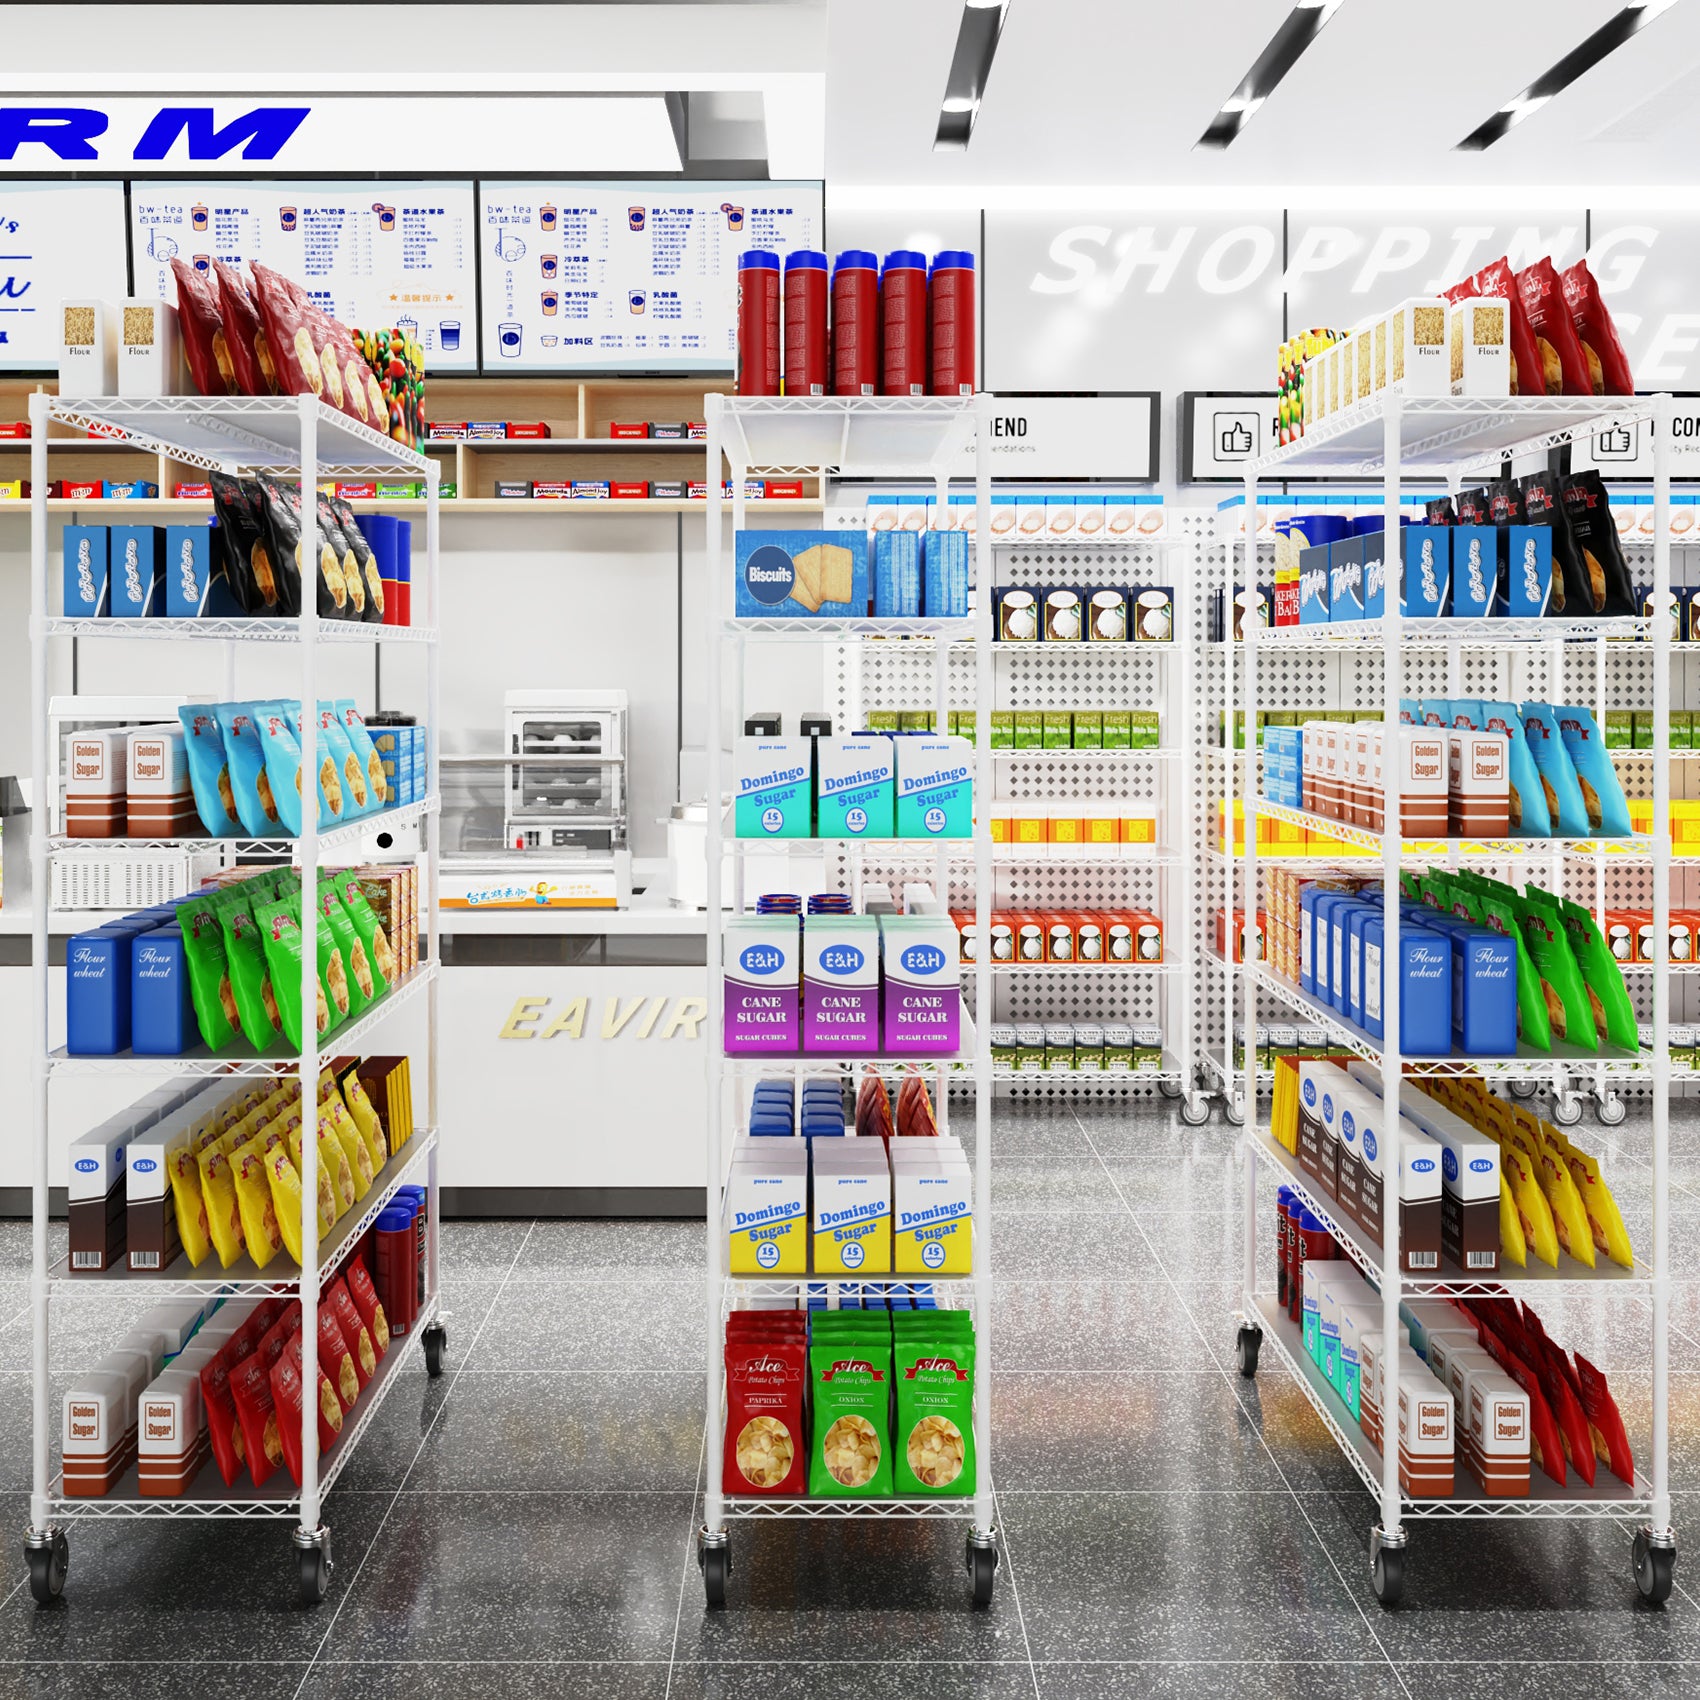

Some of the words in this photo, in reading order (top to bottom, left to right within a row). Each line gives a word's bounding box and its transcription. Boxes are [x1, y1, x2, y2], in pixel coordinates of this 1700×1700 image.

[750, 567, 792, 582] Biscuits
[871, 715, 896, 724] Fresh
[1015, 715, 1041, 724] Fresh
[1044, 715, 1071, 724] Fresh
[1075, 715, 1101, 724] Fresh
[1104, 715, 1130, 724] Fresh
[1132, 715, 1158, 724] Fresh
[77, 746, 99, 756] Golden
[137, 746, 160, 756] Golden
[1415, 745, 1438, 756] Golden
[1476, 746, 1499, 756] Golden
[77, 763, 99, 776] Sugar
[137, 763, 160, 776] Sugar
[1415, 763, 1438, 776] Sugar
[1476, 763, 1499, 776] Sugar
[740, 766, 805, 791] Domingo
[824, 766, 889, 791] Domingo
[903, 766, 968, 791] Domingo
[754, 787, 796, 807] Sugar
[838, 787, 880, 807] Sugar
[917, 787, 959, 807] Sugar
[767, 812, 778, 822] 15
[850, 812, 862, 822] 15
[930, 812, 941, 822] 15
[74, 948, 105, 966] Flour
[139, 948, 171, 966] Flour
[746, 952, 779, 968] E&H
[826, 952, 859, 968] E&H
[907, 952, 940, 968] E&H
[1410, 948, 1443, 962] Flour
[1475, 948, 1508, 963] Flour
[74, 965, 105, 977] wheat
[139, 965, 170, 977] wheat
[1410, 965, 1442, 977] wheat
[1476, 965, 1508, 977] wheat
[742, 997, 781, 1007] CANE
[822, 997, 860, 1007] CANE
[903, 997, 942, 1007] CANE
[737, 1012, 786, 1022] SUGAR
[817, 1012, 866, 1022] SUGAR
[898, 1013, 947, 1022] SUGAR
[735, 1201, 800, 1226] Domingo
[820, 1201, 885, 1226] Domingo
[900, 1201, 966, 1226] Domingo
[749, 1221, 792, 1242] Sugar
[833, 1221, 876, 1242] Sugar
[914, 1221, 958, 1242] Sugar
[762, 1246, 774, 1256] 15
[847, 1246, 859, 1256] 15
[928, 1246, 940, 1256] 15
[749, 1354, 783, 1373] Ace
[835, 1356, 869, 1374] Ace
[918, 1354, 952, 1373] Ace
[748, 1397, 783, 1405] PAPRIKA
[73, 1406, 95, 1417] Golden
[149, 1406, 171, 1417] Golden
[1422, 1406, 1445, 1417] Golden
[1498, 1406, 1521, 1417] Golden
[73, 1423, 95, 1437] Sugar
[148, 1423, 171, 1437] Sugar
[1422, 1423, 1445, 1437] Sugar
[1498, 1423, 1521, 1437] Sugar
